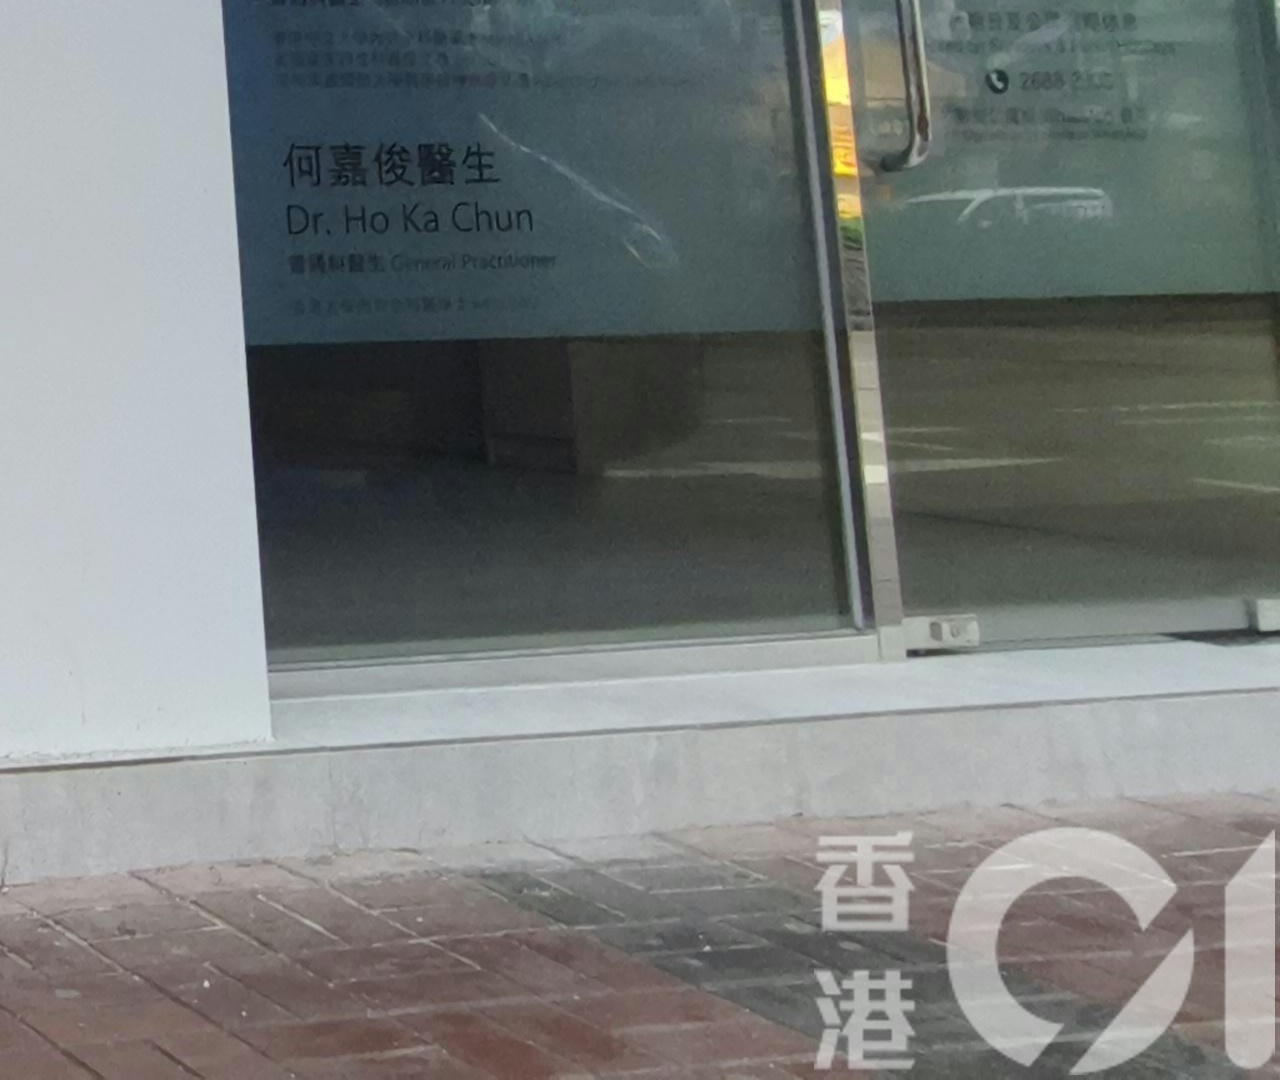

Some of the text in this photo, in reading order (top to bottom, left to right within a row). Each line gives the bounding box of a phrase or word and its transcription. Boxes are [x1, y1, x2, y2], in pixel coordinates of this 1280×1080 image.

[283, 142, 502, 188] 何嘉俊醫生
[286, 201, 534, 236] Dr. Ho Ka Chun
[391, 253, 456, 271] General
[462, 253, 557, 270] Practitioner
